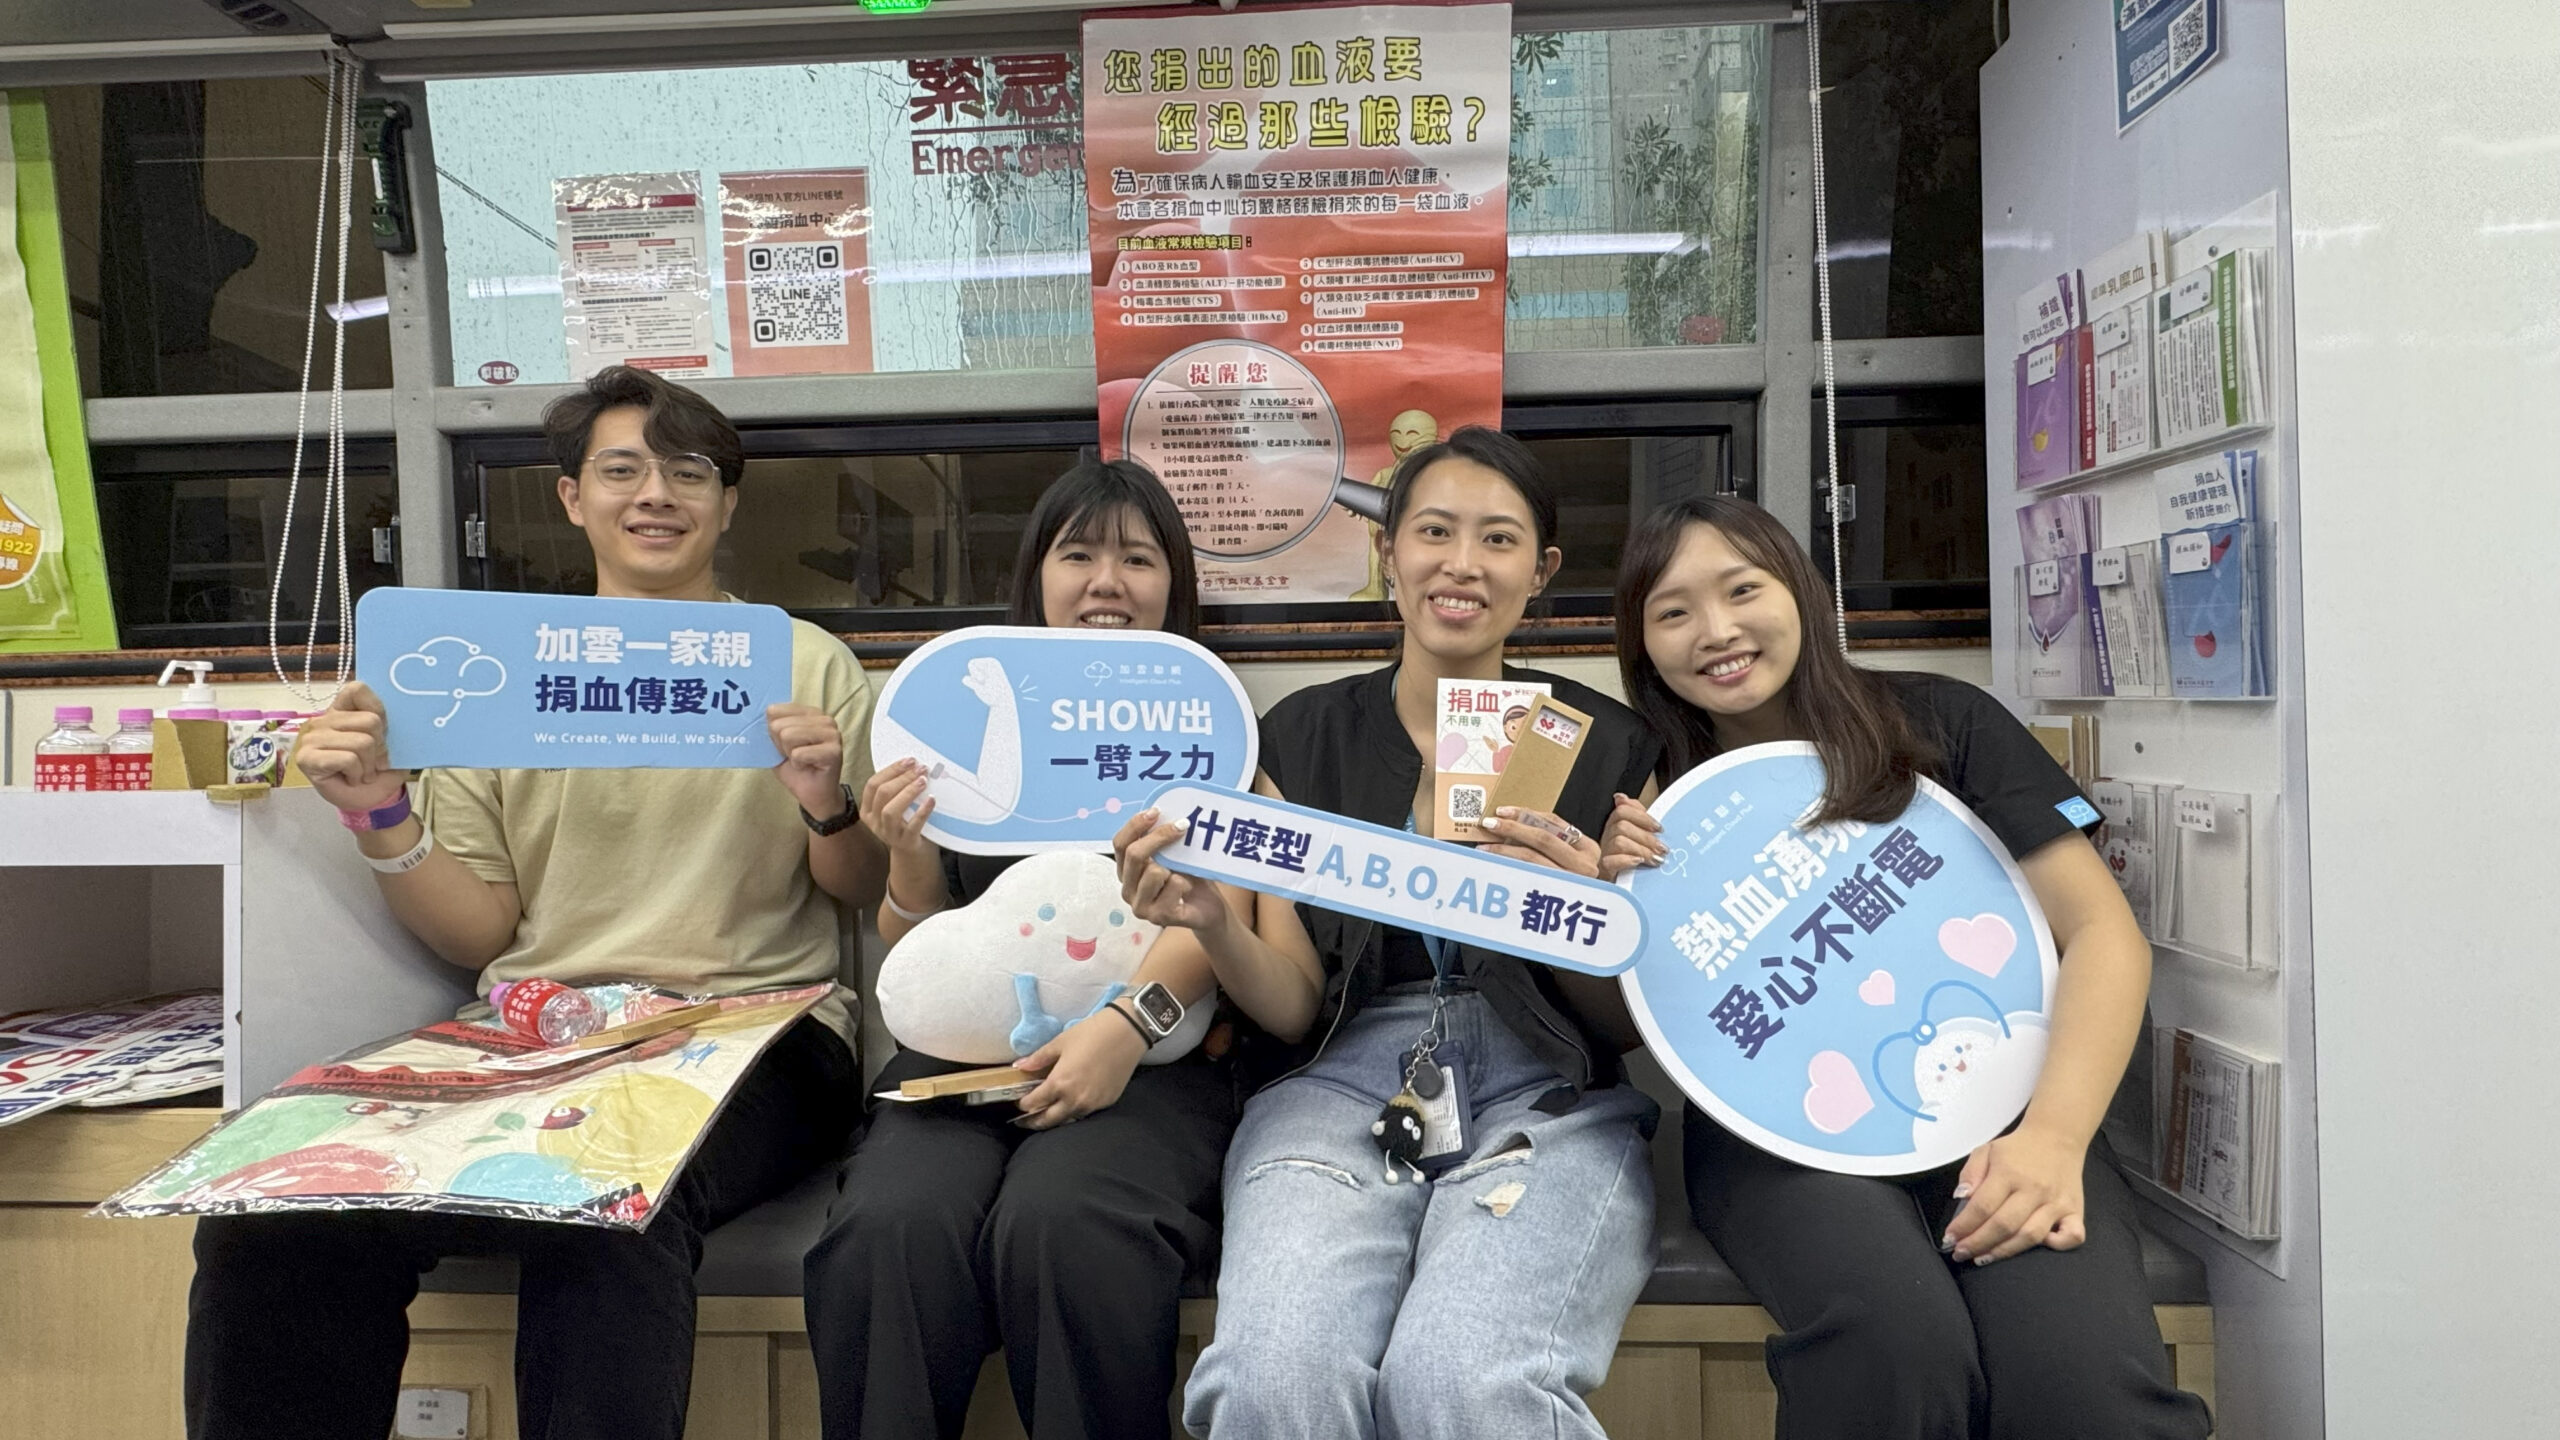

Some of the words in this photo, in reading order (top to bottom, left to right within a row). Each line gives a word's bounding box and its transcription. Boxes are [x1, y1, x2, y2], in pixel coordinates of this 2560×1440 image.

[1103, 36, 1422, 94] 您捐出的血液要
[908, 52, 1077, 123] 緊急
[1157, 95, 1486, 152] 經過那些檢驗？
[1113, 169, 1450, 192] 為了確保病人輸血安全及保護捐血人健康，
[1118, 193, 1483, 219] 本會各捐血中心均嚴格篩檢捐來的每一袋血液。
[1118, 236, 1252, 250] 目前血液常規檢驗項目：
[1134, 262, 1198, 272] ABO及Rh血型
[782, 289, 811, 300] LINE
[1190, 363, 1267, 385] 提醒您
[2195, 467, 2224, 486] 捐血人
[2170, 484, 2228, 508] 自我健康管理
[1202, 576, 1289, 588] 台灣血液基金會
[535, 623, 752, 669] 加雲一家親
[535, 674, 752, 715] 捐血傳愛心
[1448, 687, 1501, 713] 捐血
[1050, 697, 1213, 735] SHOW出
[1446, 715, 1481, 727] 不用等
[534, 733, 557, 744] We
[561, 732, 612, 745] Create,
[616, 734, 639, 744] We
[642, 733, 681, 745] Build,
[685, 735, 705, 745] We
[709, 734, 750, 745] Share.
[1050, 744, 1215, 781] 一臂之力
[1183, 806, 1313, 874] 什麼型
[1316, 843, 1353, 887] A,
[1361, 854, 1396, 897] B,
[1406, 864, 1444, 910] O,
[1448, 877, 1511, 919] AB
[1519, 889, 1608, 947] 都行
[1708, 825, 1944, 1060] 愛心不斷電
